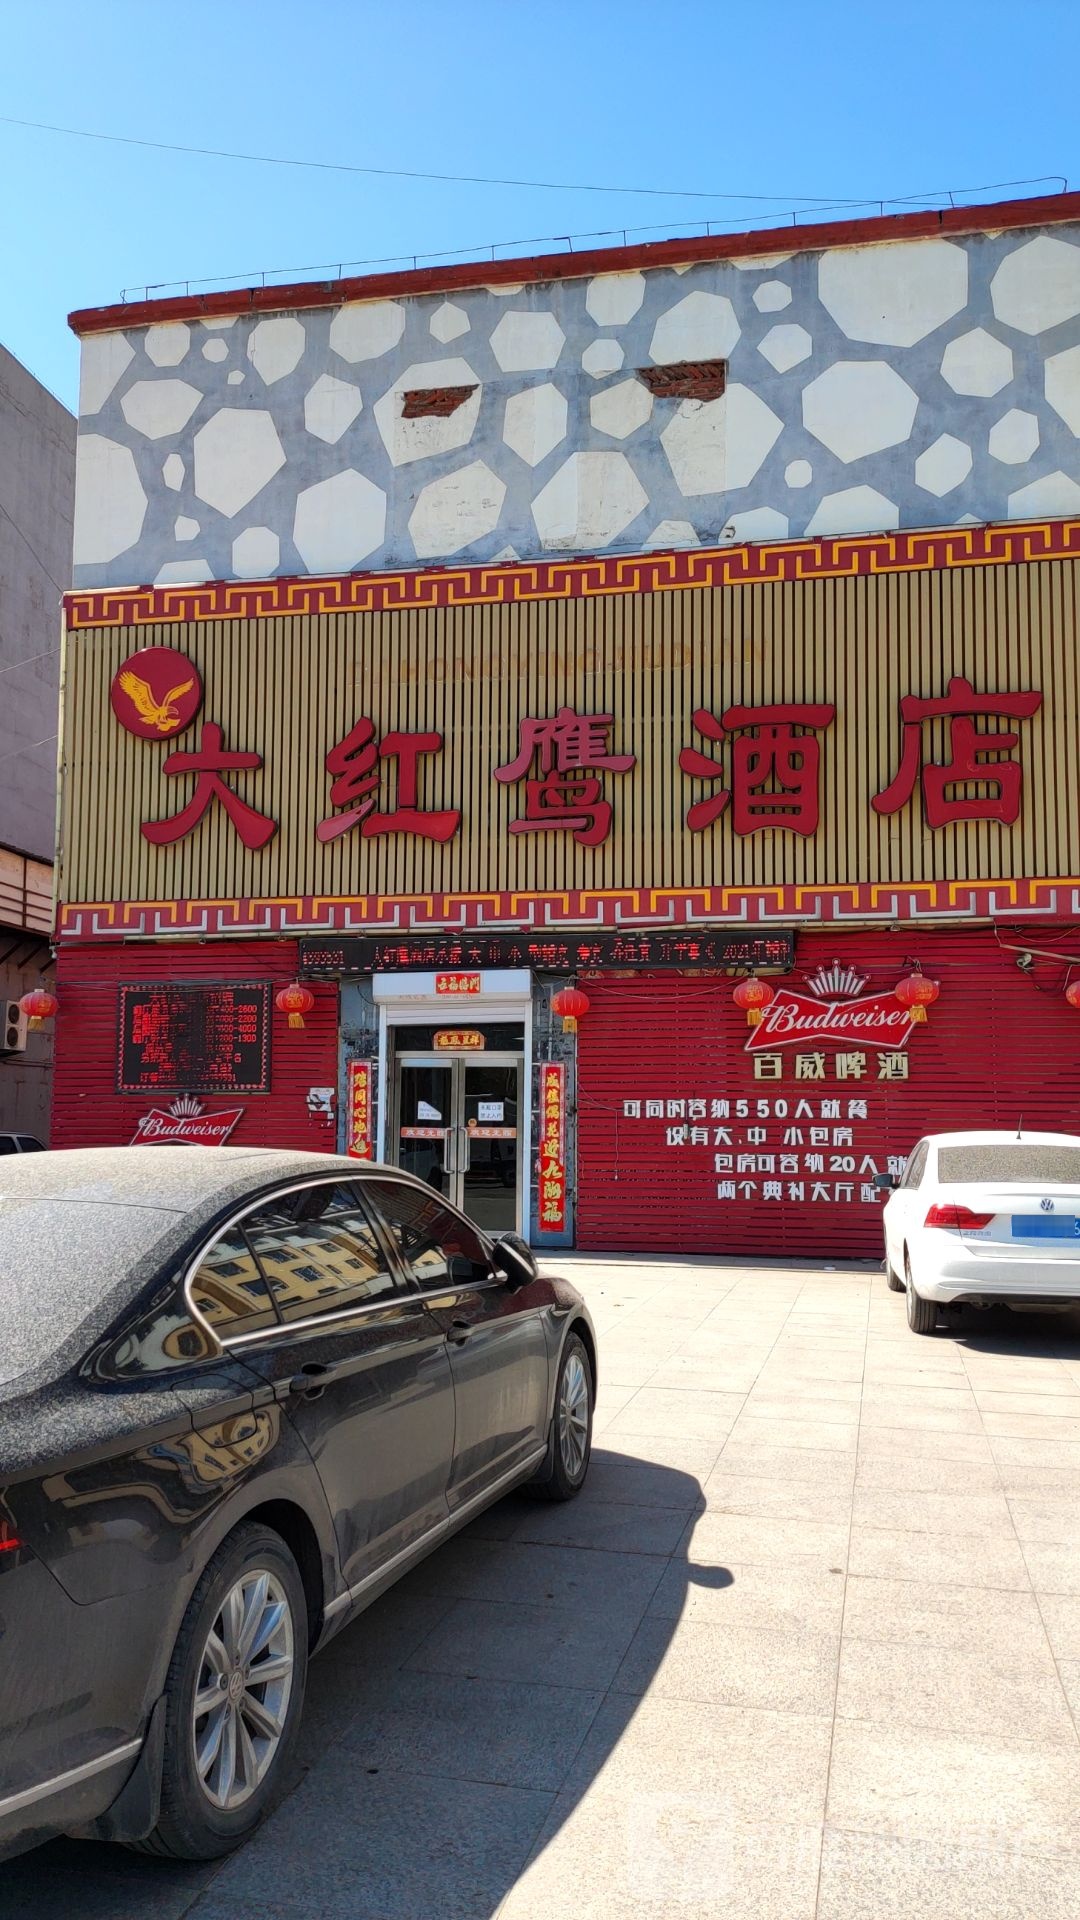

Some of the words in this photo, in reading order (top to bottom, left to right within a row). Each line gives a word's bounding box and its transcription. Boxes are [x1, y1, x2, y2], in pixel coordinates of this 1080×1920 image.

[140, 674, 1043, 849] 大红鹰酒店
[761, 1002, 911, 1034] Budweiser
[753, 1051, 909, 1080] 百威啤酒
[623, 1098, 868, 1120] 可同时容纳550人就餐
[138, 1117, 232, 1138] Budweiser
[718, 1180, 896, 1203] 两个典礼大厅配
